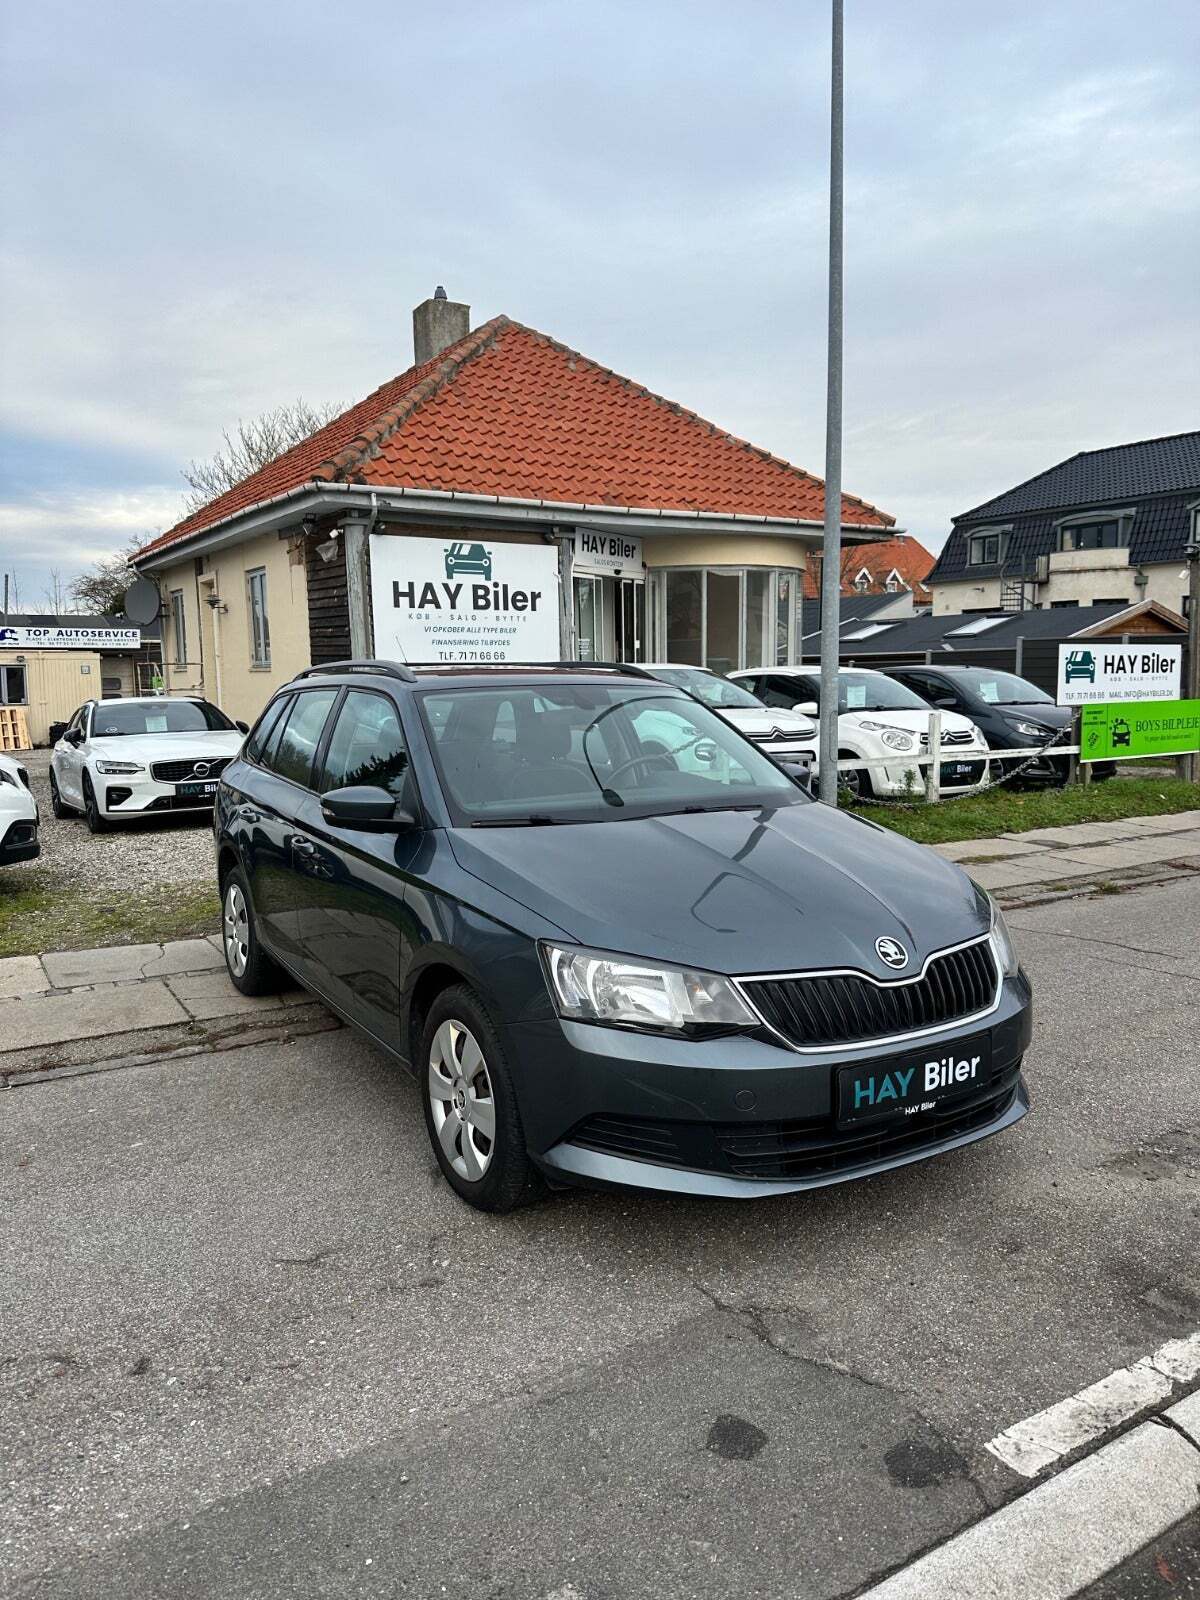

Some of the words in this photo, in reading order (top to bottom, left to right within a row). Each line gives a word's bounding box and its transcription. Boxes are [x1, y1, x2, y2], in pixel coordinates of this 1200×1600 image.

[582, 533, 607, 554] HAY
[609, 537, 636, 558] Biler
[392, 580, 463, 609] HAY
[472, 582, 541, 611] Biler
[26, 629, 50, 637] TOP
[57, 630, 138, 638] AUTOSERVICE
[459, 652, 467, 660] 71
[469, 652, 477, 660] 71
[479, 652, 491, 660] 66
[494, 652, 506, 660] 66
[1103, 655, 1138, 674] HAY
[1141, 652, 1176, 673] Biler
[1135, 719, 1160, 732] BOYS
[854, 1067, 915, 1109] HAY
[925, 1056, 980, 1091] Biler
[905, 1104, 920, 1115] HAY
[920, 1101, 936, 1111] Biler
